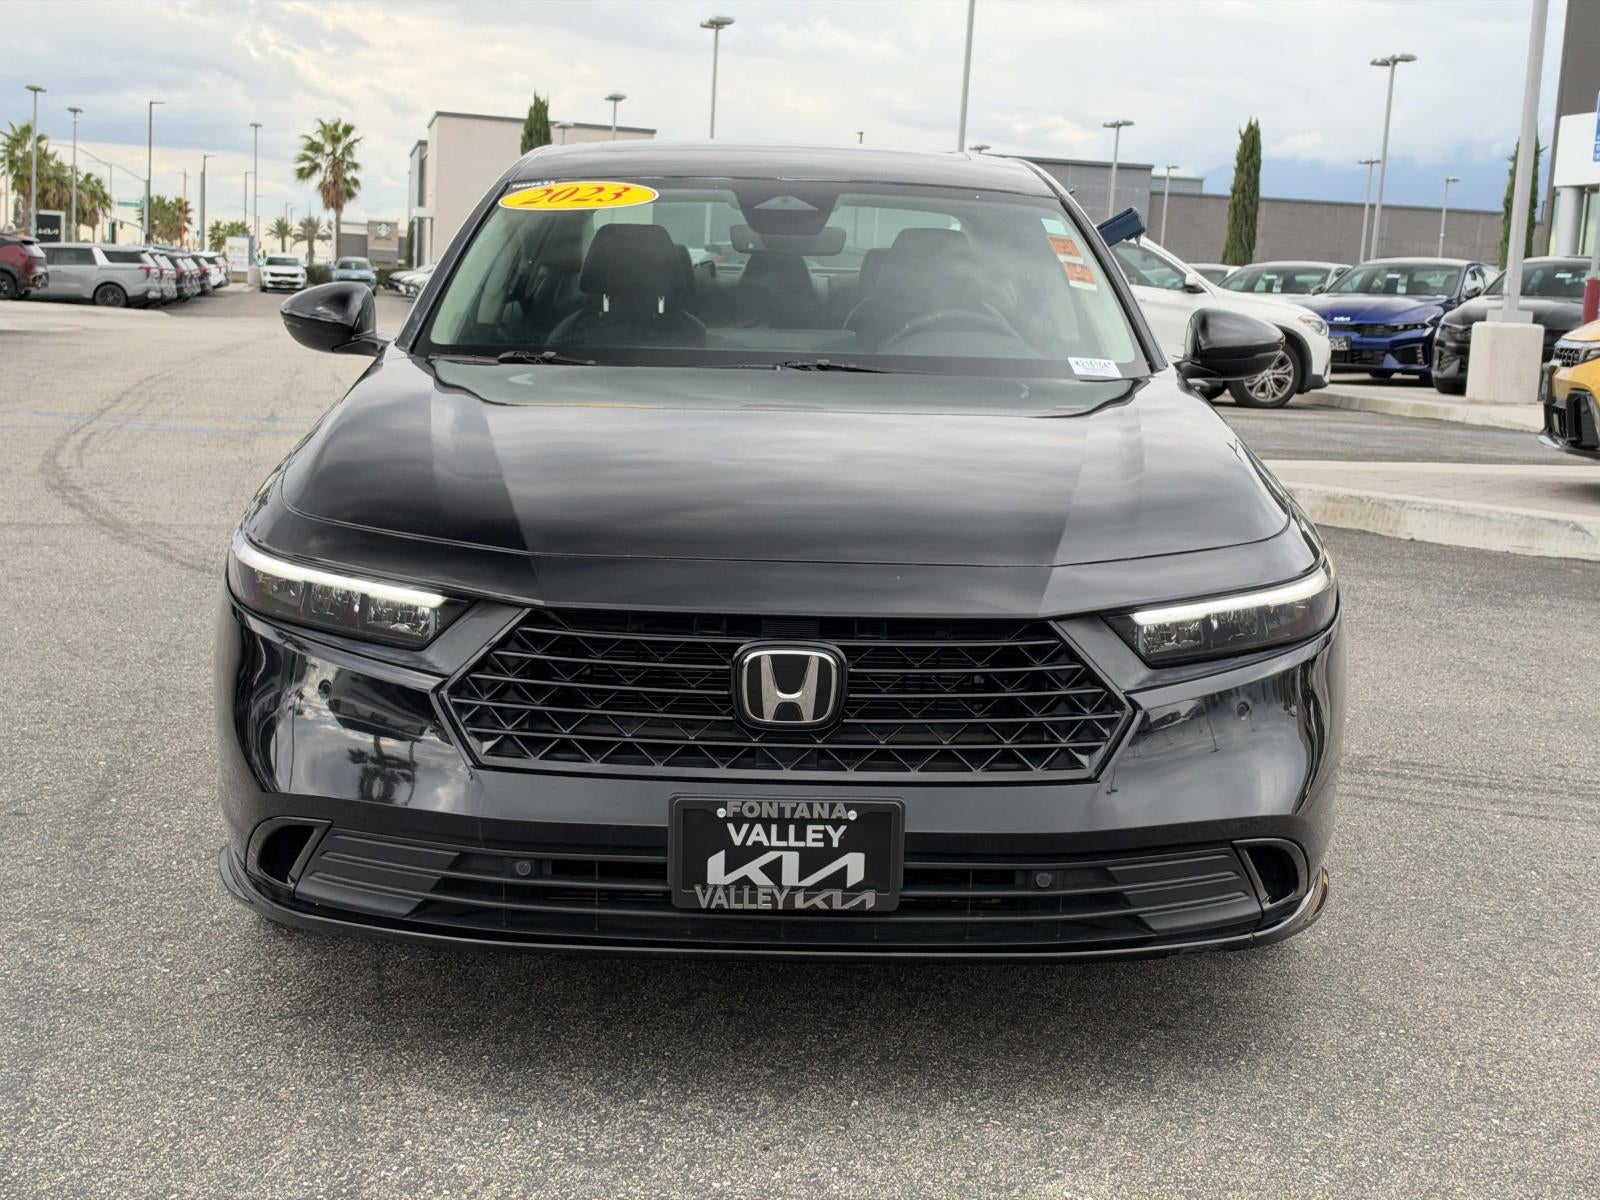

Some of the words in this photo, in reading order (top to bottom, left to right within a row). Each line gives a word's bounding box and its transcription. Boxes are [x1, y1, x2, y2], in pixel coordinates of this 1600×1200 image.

[519, 187, 630, 205] 2023
[726, 801, 849, 820] FONTANA
[726, 823, 847, 848] VALLEY
[707, 849, 866, 888] KIA
[695, 885, 790, 910] VALLEY
[794, 888, 876, 911] KIA
